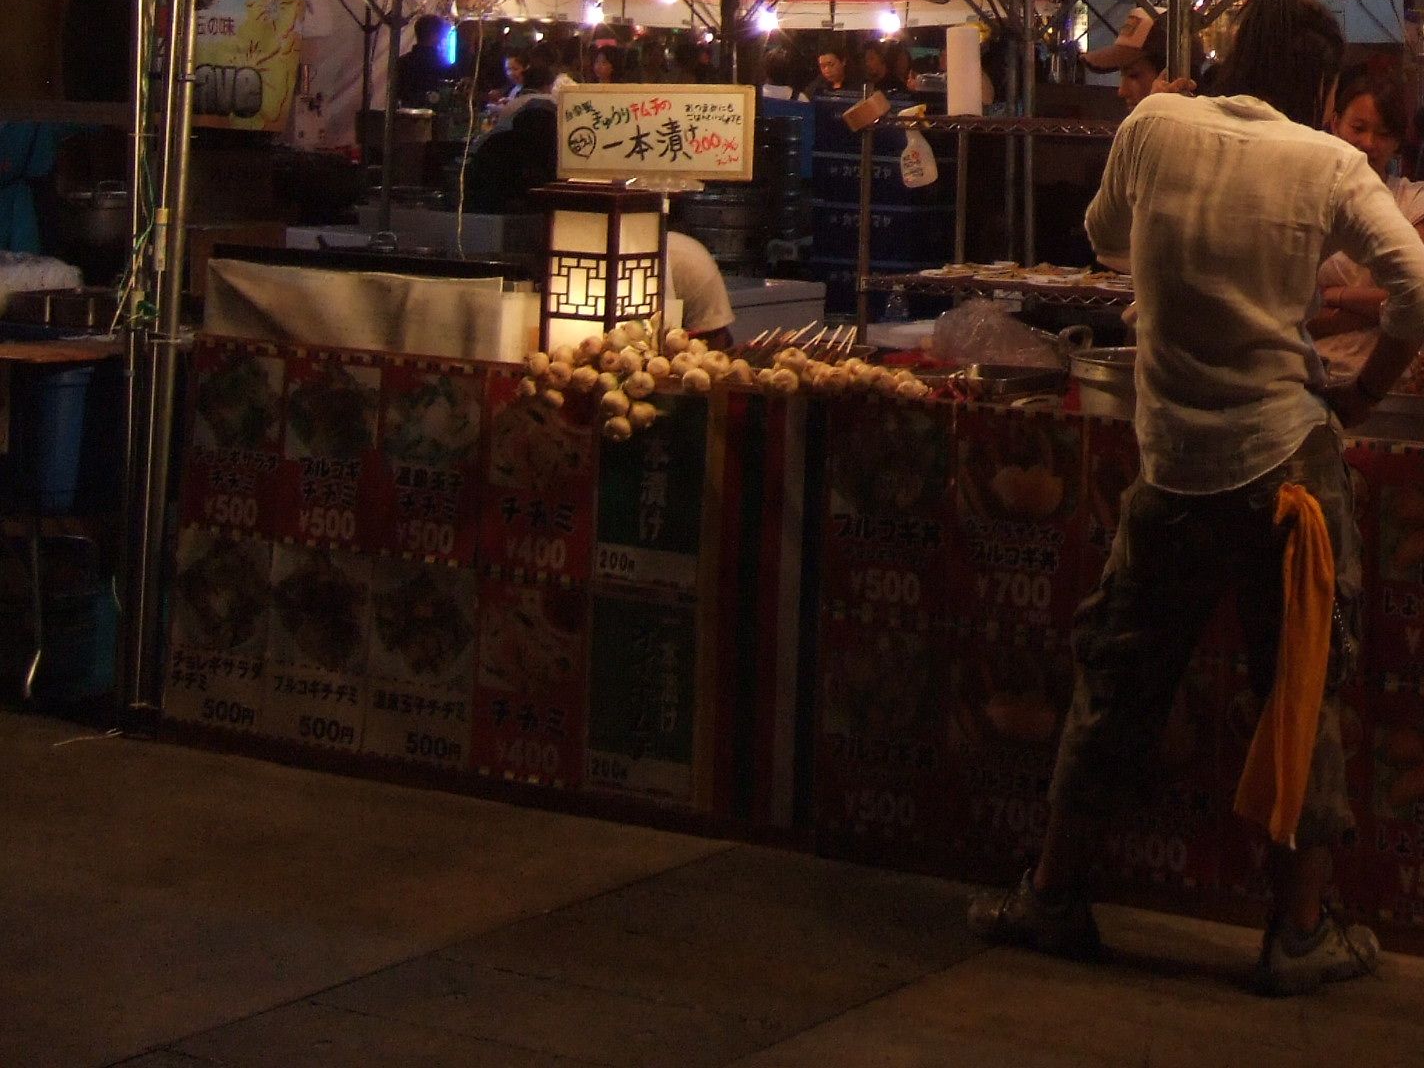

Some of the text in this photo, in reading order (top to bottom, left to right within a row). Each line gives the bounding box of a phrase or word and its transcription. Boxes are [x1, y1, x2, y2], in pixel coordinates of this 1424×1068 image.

[602, 118, 698, 163] 一本漬け
[205, 494, 258, 527] ¥500
[299, 507, 356, 540] ¥500
[506, 534, 567, 570] ¥400
[850, 568, 921, 607] ¥500
[976, 571, 1052, 609] ¥700
